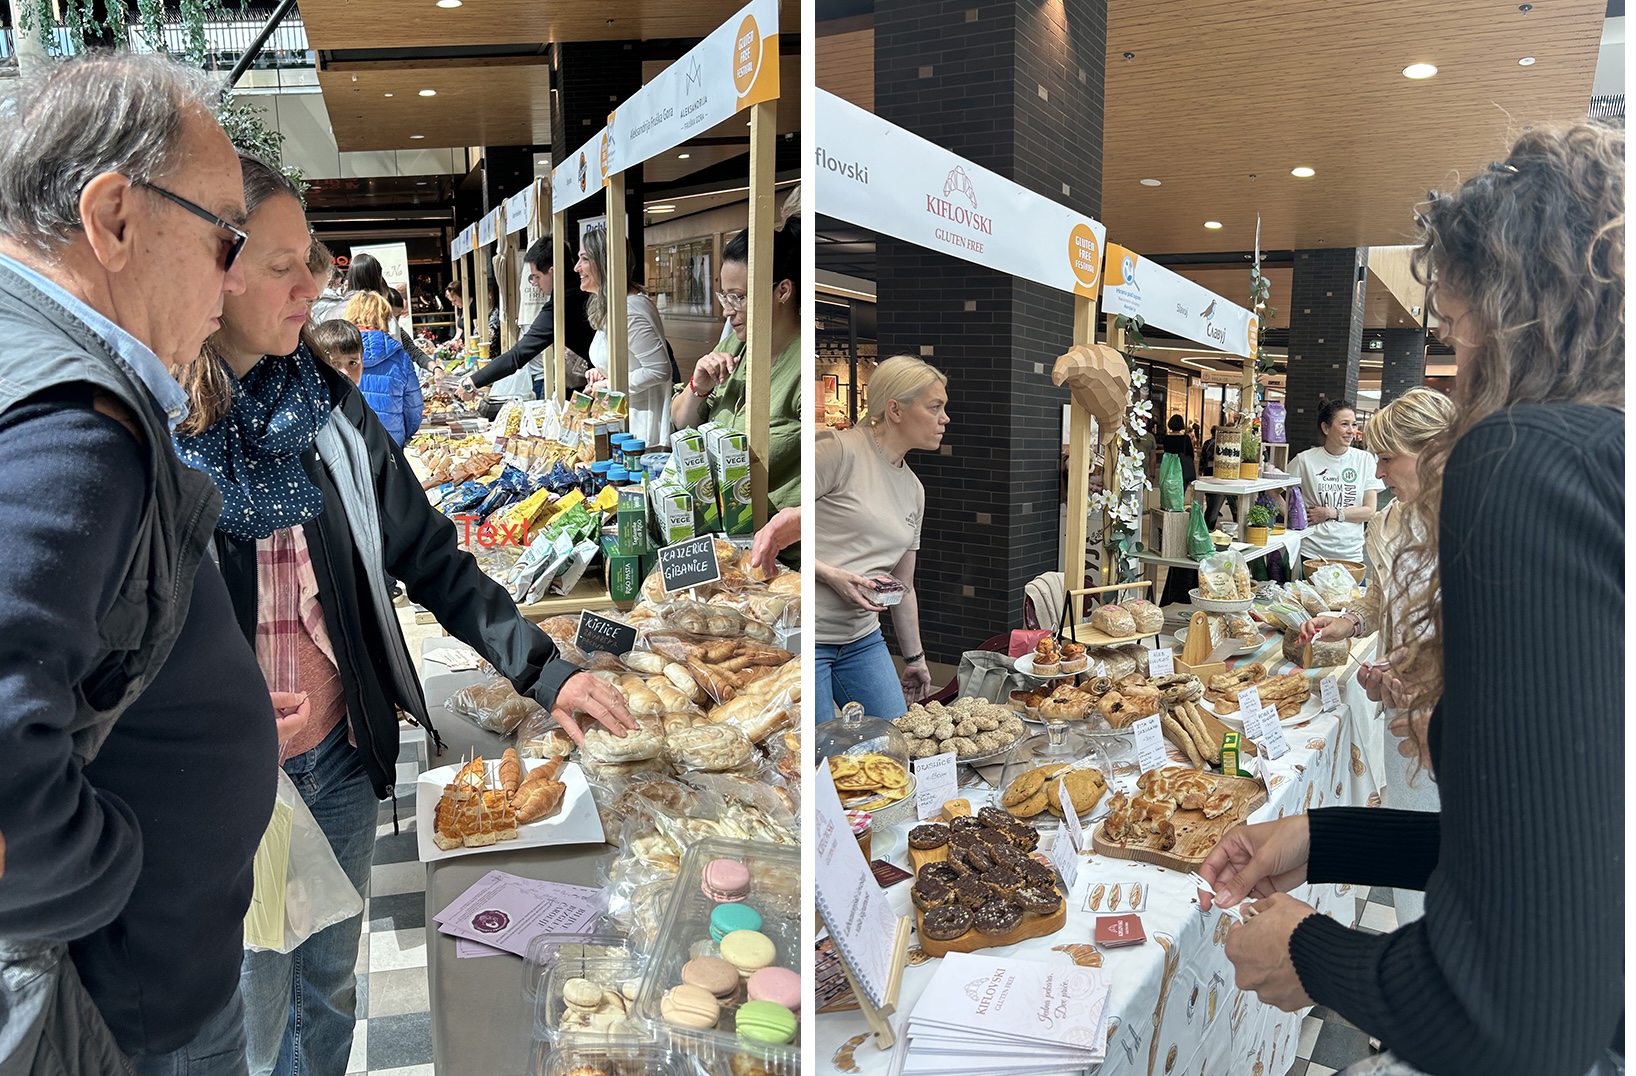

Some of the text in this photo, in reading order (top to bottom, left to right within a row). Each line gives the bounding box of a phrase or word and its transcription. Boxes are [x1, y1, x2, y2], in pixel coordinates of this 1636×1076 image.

[738, 30, 754, 51] GLUTEN
[740, 46, 751, 63] FREE
[736, 61, 753, 79] FESTIVAL
[662, 107, 674, 122] Gora
[680, 96, 708, 119] ALEKSANDRIJA
[926, 193, 993, 235] KIFLOVSKI
[935, 228, 984, 254] GLUTEN FREE
[1075, 235, 1095, 251] GLUTEN
[1079, 248, 1092, 262] FREE
[1075, 259, 1095, 274] FESTIVAL
[685, 458, 705, 467] VEGE
[726, 456, 746, 465] VEGE
[670, 516, 691, 525] VEGE
[976, 968, 1006, 1015] KIFLOVSKI
[994, 975, 1016, 1012] GLUTEN FREE
[1037, 1000, 1054, 1030] Jedna
[1054, 999, 1068, 1019] Dve
